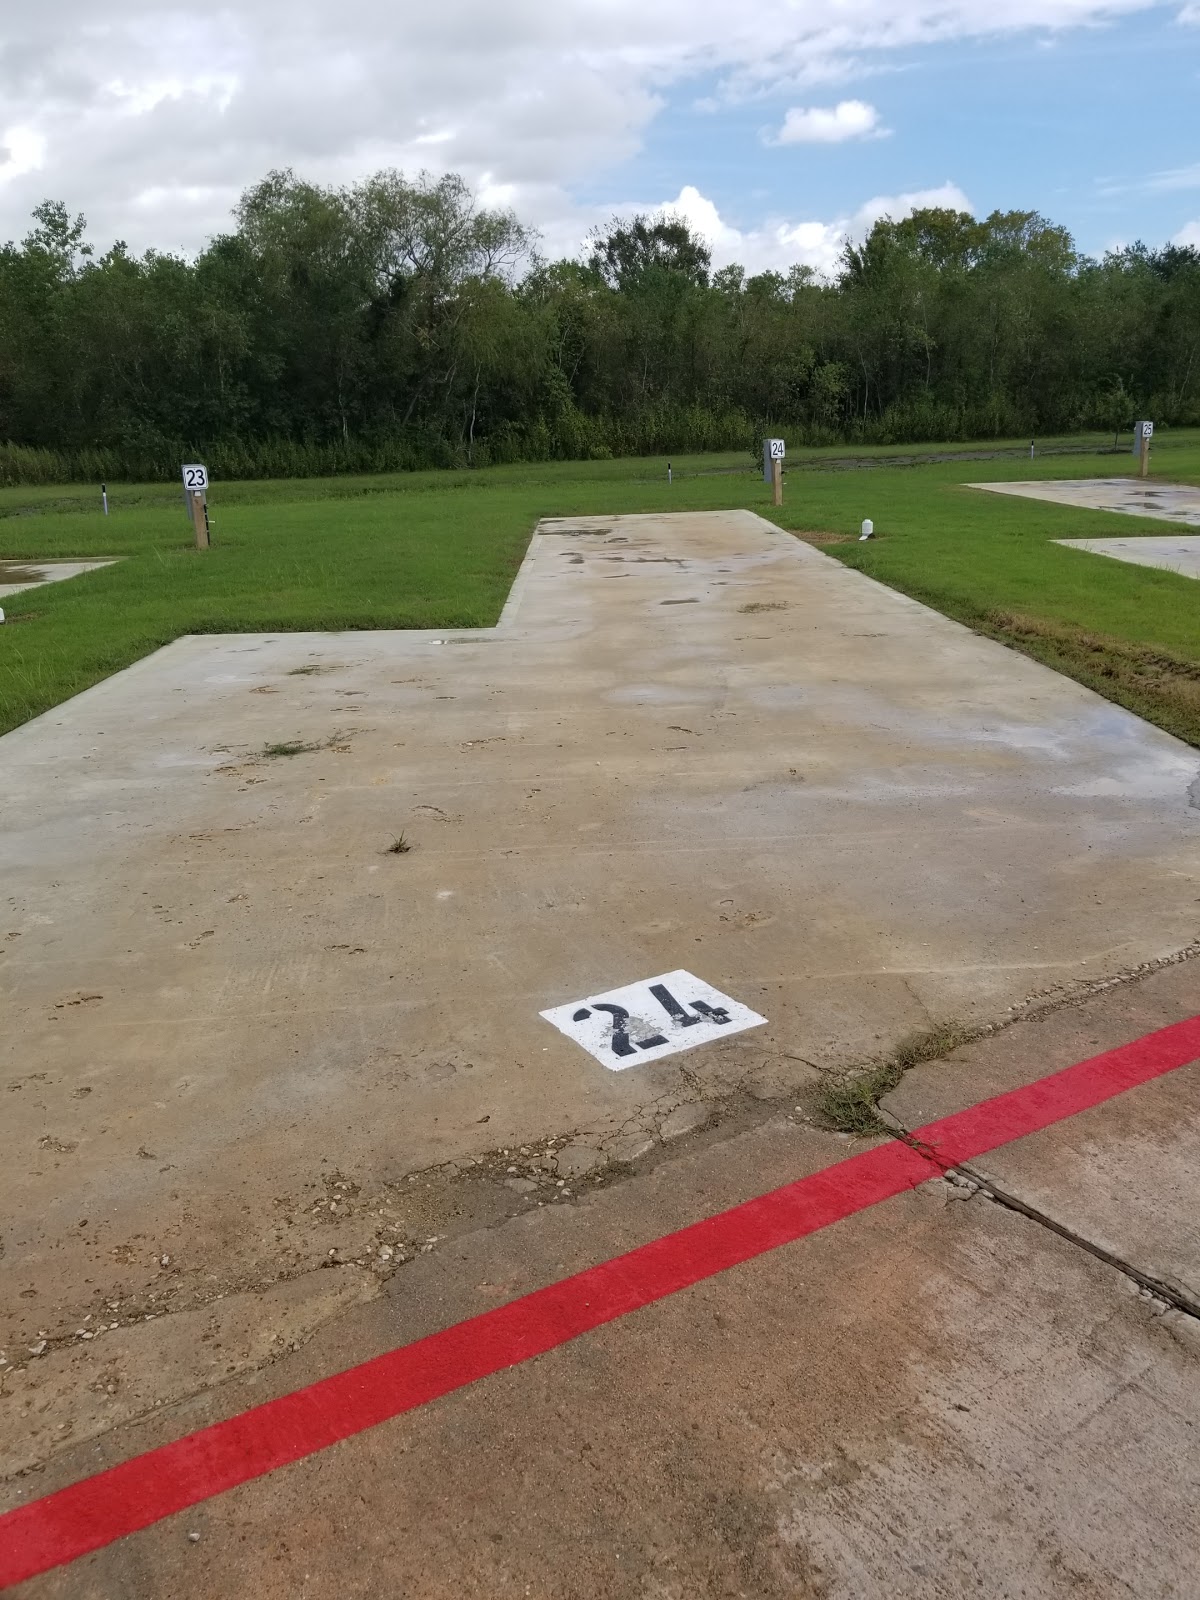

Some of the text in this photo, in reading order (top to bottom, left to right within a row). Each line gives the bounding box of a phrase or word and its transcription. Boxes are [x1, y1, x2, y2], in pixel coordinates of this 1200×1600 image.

[772, 442, 784, 456] 24
[186, 469, 205, 487] 23
[572, 983, 733, 1057] 24
